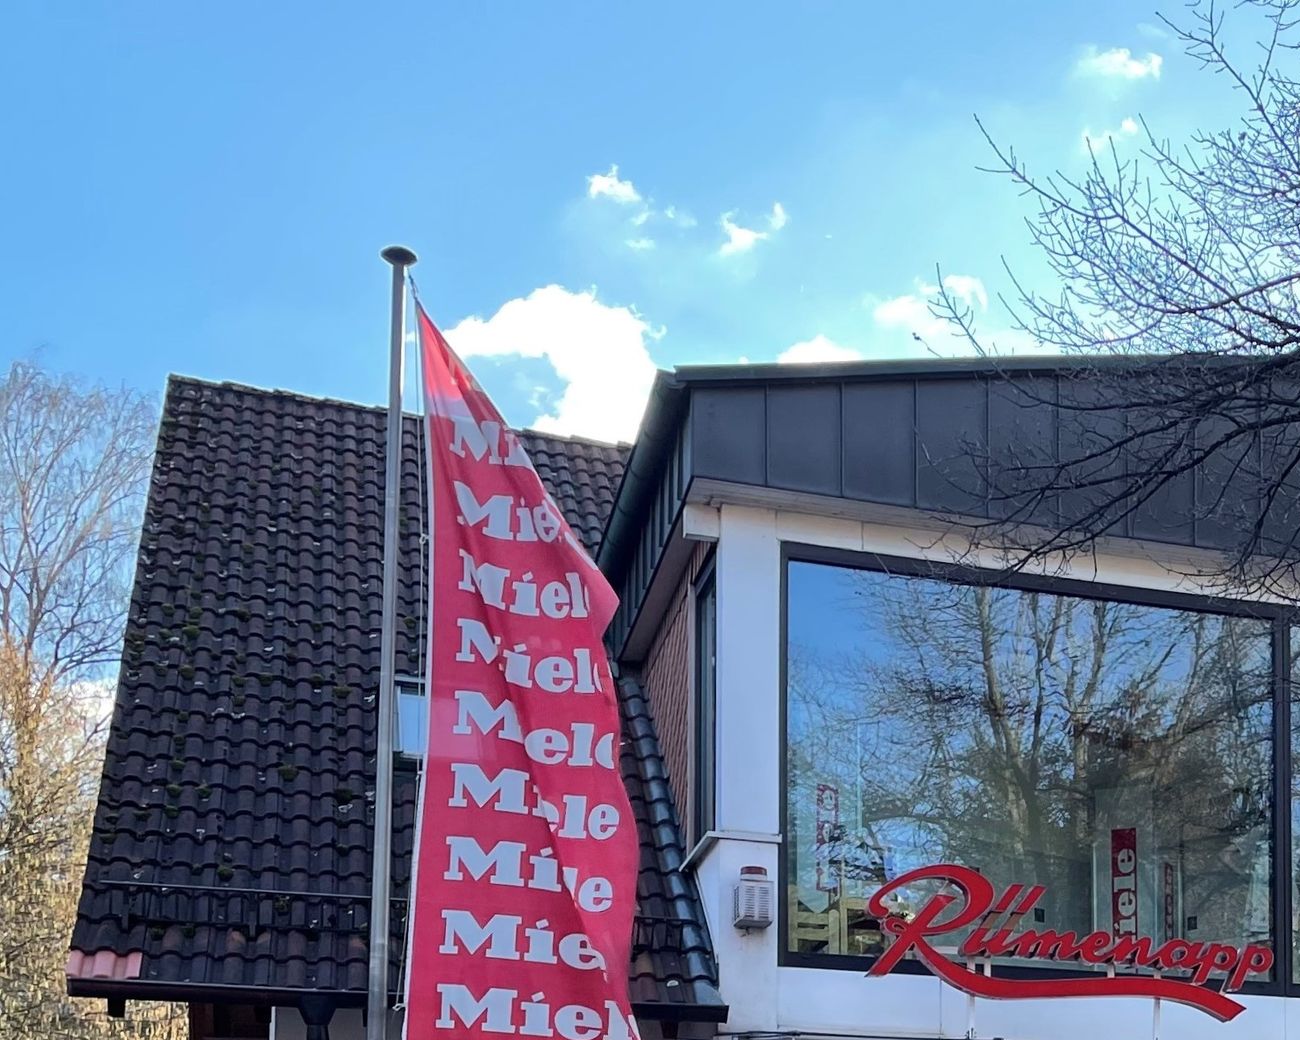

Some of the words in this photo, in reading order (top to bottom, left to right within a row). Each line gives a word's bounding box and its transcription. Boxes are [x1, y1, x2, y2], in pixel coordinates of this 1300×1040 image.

[453, 480, 580, 555] Mie
[458, 548, 590, 619] Miel
[455, 618, 604, 694] Miel
[1113, 848, 1136, 945] iele
[438, 909, 606, 972] Mie
[863, 864, 1274, 1023] Rümenapp
